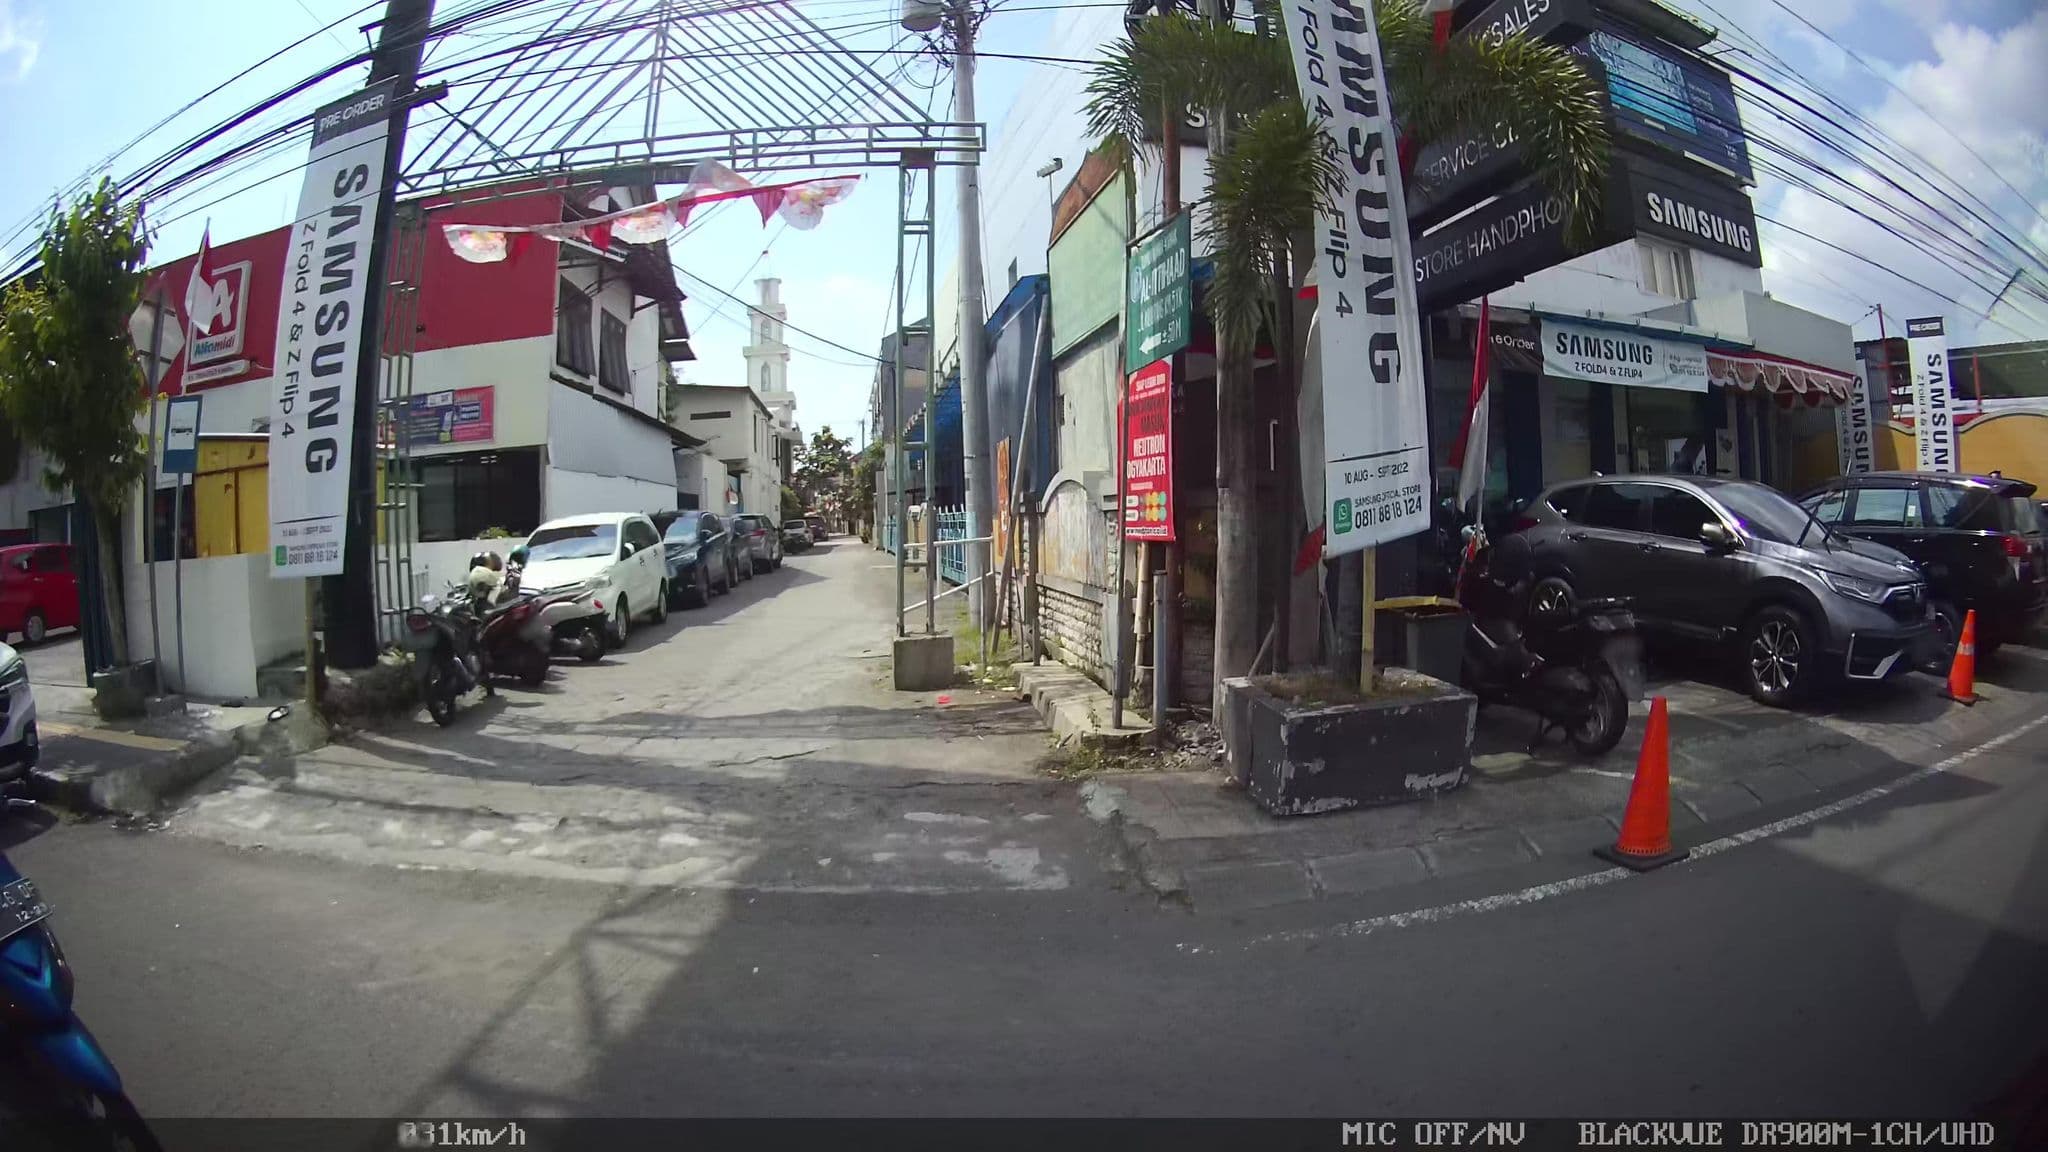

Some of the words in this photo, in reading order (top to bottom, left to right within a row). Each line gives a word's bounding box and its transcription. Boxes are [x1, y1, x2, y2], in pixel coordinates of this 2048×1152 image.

[1298, 6, 1330, 88] Fold
[319, 110, 342, 132] PRE
[342, 94, 385, 121] ORDER
[1314, 95, 1334, 119] 4
[1330, 0, 1401, 384] AMSUNG
[302, 220, 318, 236] Z
[1647, 192, 1752, 253] SAMSUNG
[1326, 206, 1350, 279] Flip
[1415, 240, 1463, 283] STORE
[1466, 198, 1565, 259] HANDPHO
[294, 239, 314, 293] Fold
[291, 301, 306, 315] 4
[305, 163, 369, 474] SAMSUNG
[1335, 290, 1353, 318] 4
[289, 325, 304, 343] &
[1556, 332, 1653, 366] SAMSUNG
[284, 348, 301, 366] Z
[1574, 361, 1580, 372] Z
[1581, 362, 1608, 375] FOLD4
[1609, 366, 1616, 376] &
[1617, 366, 1624, 377] Z
[1624, 367, 1643, 378] FLIP4
[279, 371, 300, 415] Flip
[1927, 353, 1949, 473] SAMSUN
[281, 422, 296, 439] 4
[1133, 433, 1166, 457] NEUTRON
[1126, 456, 1166, 478] OGYAKARTA
[1353, 469, 1369, 484] AUG
[1401, 483, 1421, 496] STORE
[1354, 507, 1377, 529] 0811
[1378, 504, 1391, 523] 88
[1404, 495, 1422, 516] 124
